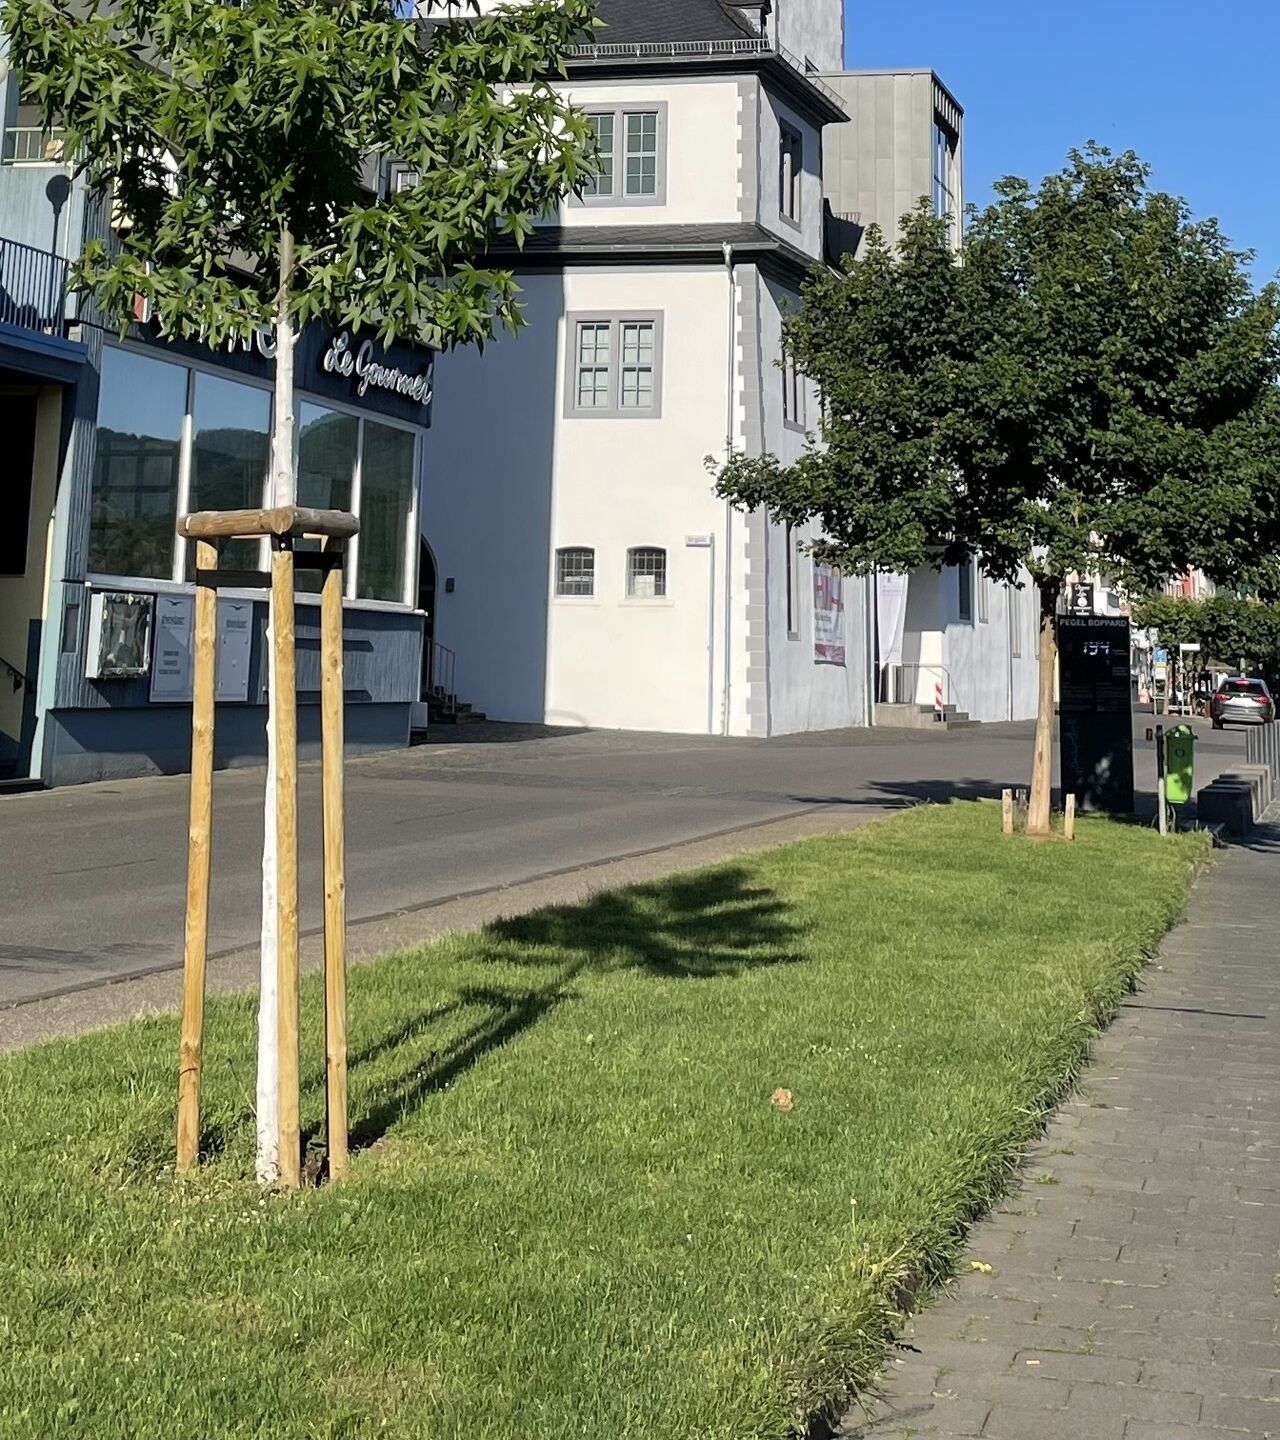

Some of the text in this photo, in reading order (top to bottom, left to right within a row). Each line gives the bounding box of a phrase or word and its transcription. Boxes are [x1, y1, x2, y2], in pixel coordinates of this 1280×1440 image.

[323, 330, 354, 377] Le
[355, 339, 433, 405] Gourmet
[1059, 618, 1128, 627] PEGEL BOPPARD
